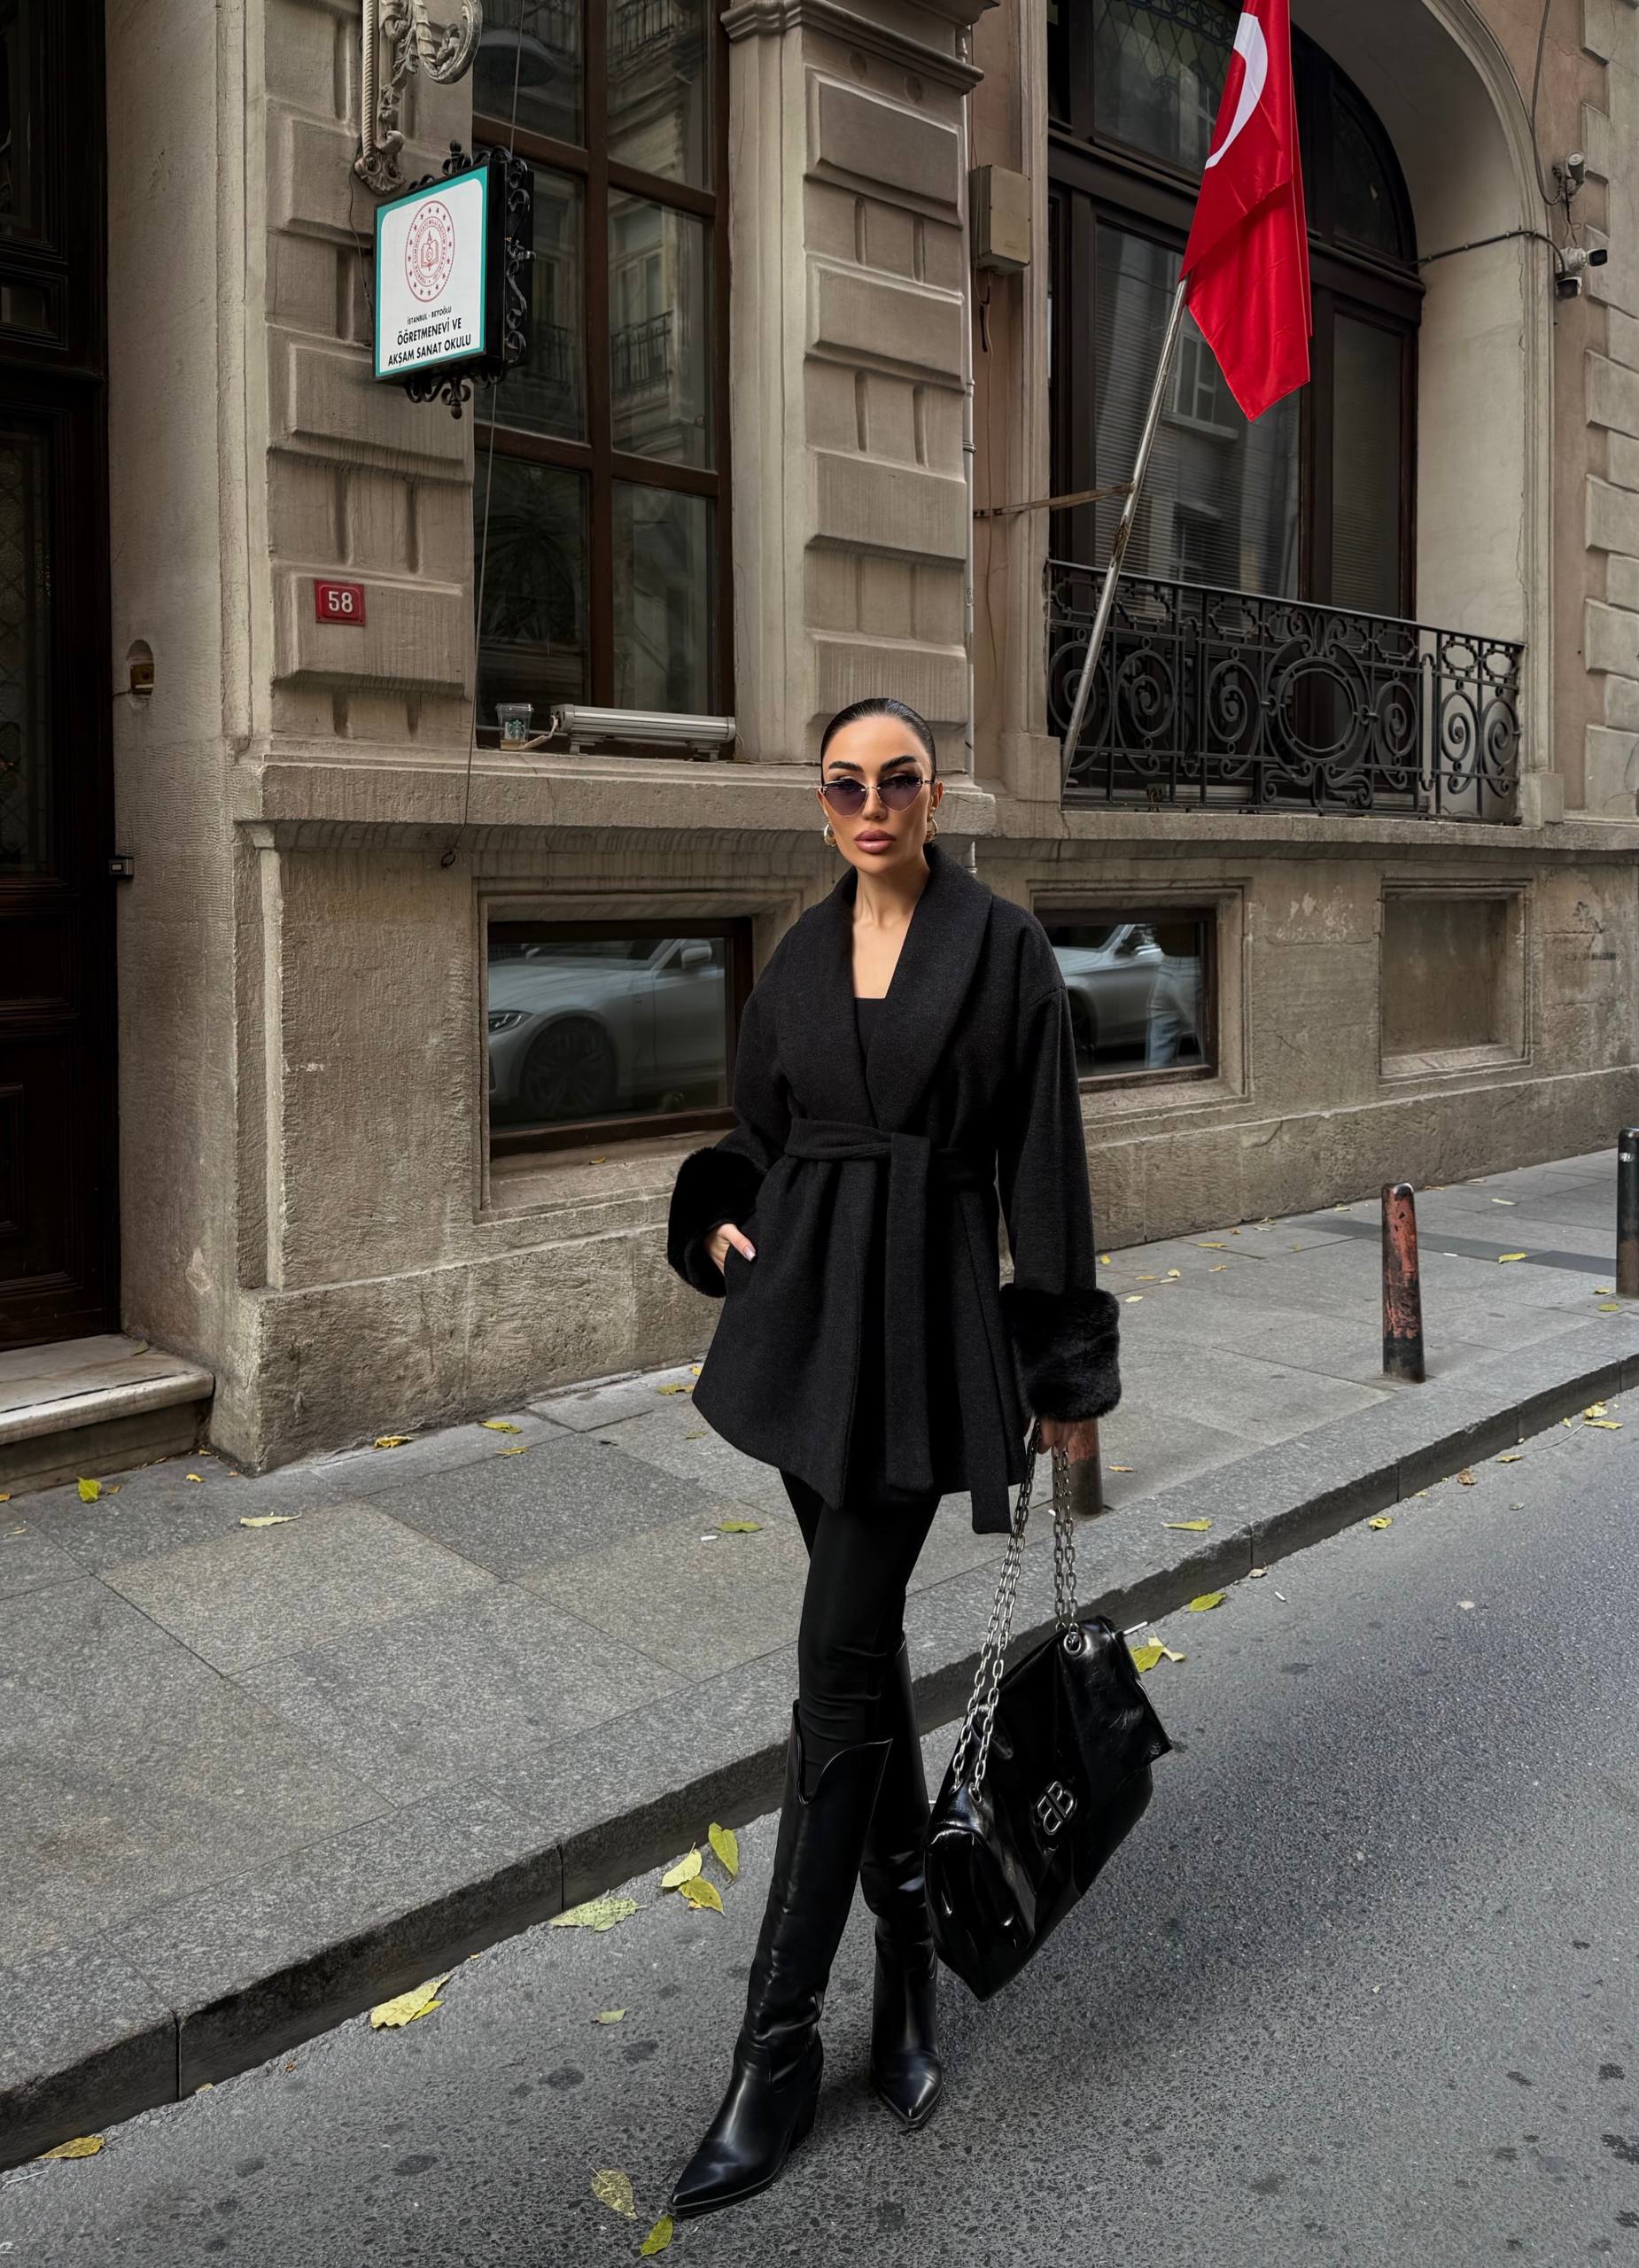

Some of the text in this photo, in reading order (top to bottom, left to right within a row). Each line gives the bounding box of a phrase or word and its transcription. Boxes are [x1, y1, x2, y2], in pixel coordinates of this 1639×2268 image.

[397, 317, 462, 346] ÖĞRETMENEVİ VE
[388, 334, 472, 366] AKŞAM SANAT OKULU
[329, 591, 353, 613] 58
